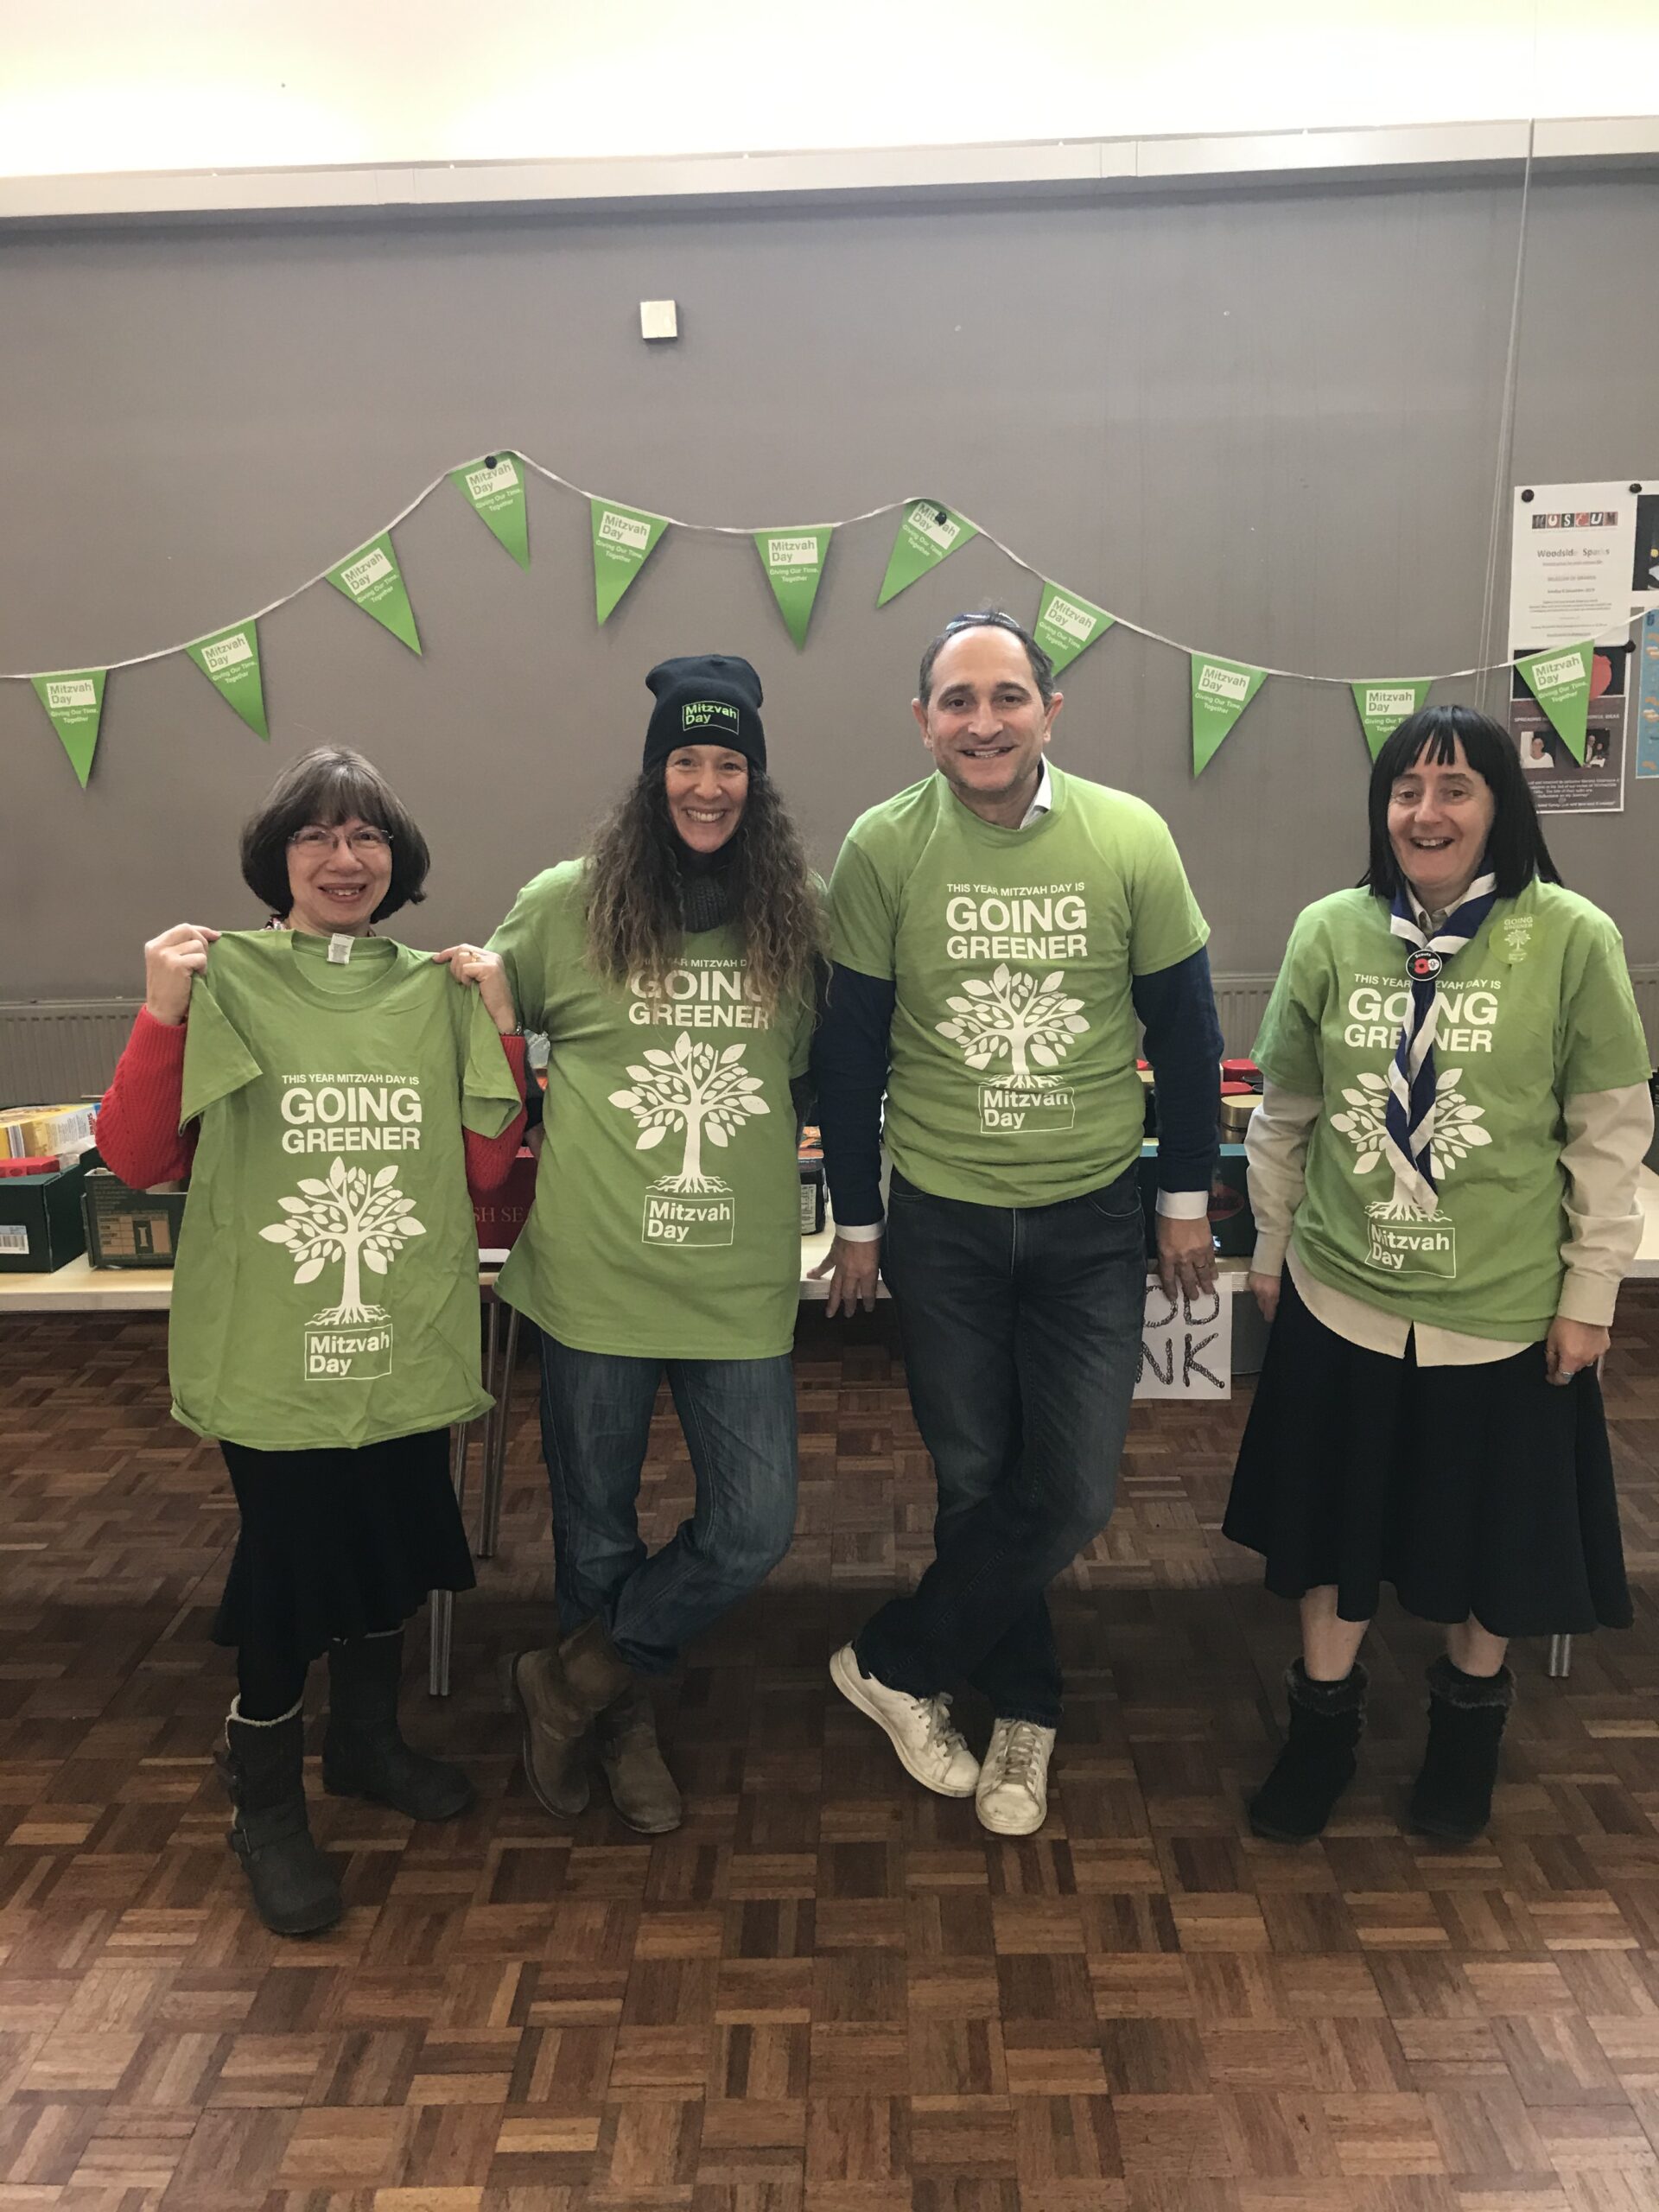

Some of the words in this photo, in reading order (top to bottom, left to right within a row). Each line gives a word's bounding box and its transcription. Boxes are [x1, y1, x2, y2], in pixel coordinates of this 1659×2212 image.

[468, 463, 512, 486] Mitzvah
[473, 482, 493, 495] Day
[604, 514, 647, 536] Mitzvah
[912, 512, 932, 531] Day
[918, 503, 956, 537] Mitah
[602, 524, 624, 540] Day
[771, 540, 815, 551] Mitzvah
[1537, 549, 1577, 557] Woodsid
[344, 553, 383, 582] Mitzvah
[772, 552, 793, 563] Day
[350, 574, 371, 590] Day
[1047, 608, 1069, 626] Day
[1053, 600, 1092, 628] Mitzvah
[205, 637, 245, 659] Mitzvah
[208, 655, 229, 668] Day
[1535, 657, 1580, 677] Mitzvah
[1201, 677, 1223, 692] Day
[1204, 668, 1246, 688] Mitzvah
[1538, 674, 1559, 686] Day
[49, 683, 92, 695] Mitzvah
[1369, 692, 1412, 702] Mitzvah
[51, 695, 72, 705] Day
[1369, 702, 1389, 713] Day
[685, 703, 737, 720] Mitzvah
[685, 714, 711, 725] Day
[947, 883, 970, 893] THIS
[973, 884, 999, 895] YEAR
[1001, 886, 1047, 897] MITZVAH
[1050, 883, 1072, 893] DAY
[1075, 882, 1085, 892] IS
[946, 895, 1087, 933] GOING
[946, 934, 1088, 960] GREENER
[690, 959, 737, 968] MITZVAH
[1354, 974, 1379, 984] THIS
[1382, 977, 1412, 988] YEAR
[1466, 979, 1488, 988] DAY
[1491, 980, 1502, 989] IS
[628, 1001, 769, 1030] GREENER
[1348, 988, 1498, 1026] GONG
[1344, 1024, 1493, 1052] GRENER
[282, 1074, 307, 1084] THIS
[308, 1073, 334, 1083] YEAR
[337, 1074, 383, 1084] MITZVAH
[385, 1075, 406, 1084] DAY
[410, 1077, 420, 1085] IS
[281, 1087, 423, 1124] GOING
[983, 1109, 1026, 1129] Day
[282, 1127, 421, 1154] GREENER
[649, 1200, 730, 1222] Mitzvah
[647, 1218, 690, 1243] Day
[1371, 1224, 1450, 1250] Mitzvah
[1372, 1242, 1405, 1269] Day
[310, 1332, 390, 1354] Mitzvah
[309, 1355, 353, 1376] Day
